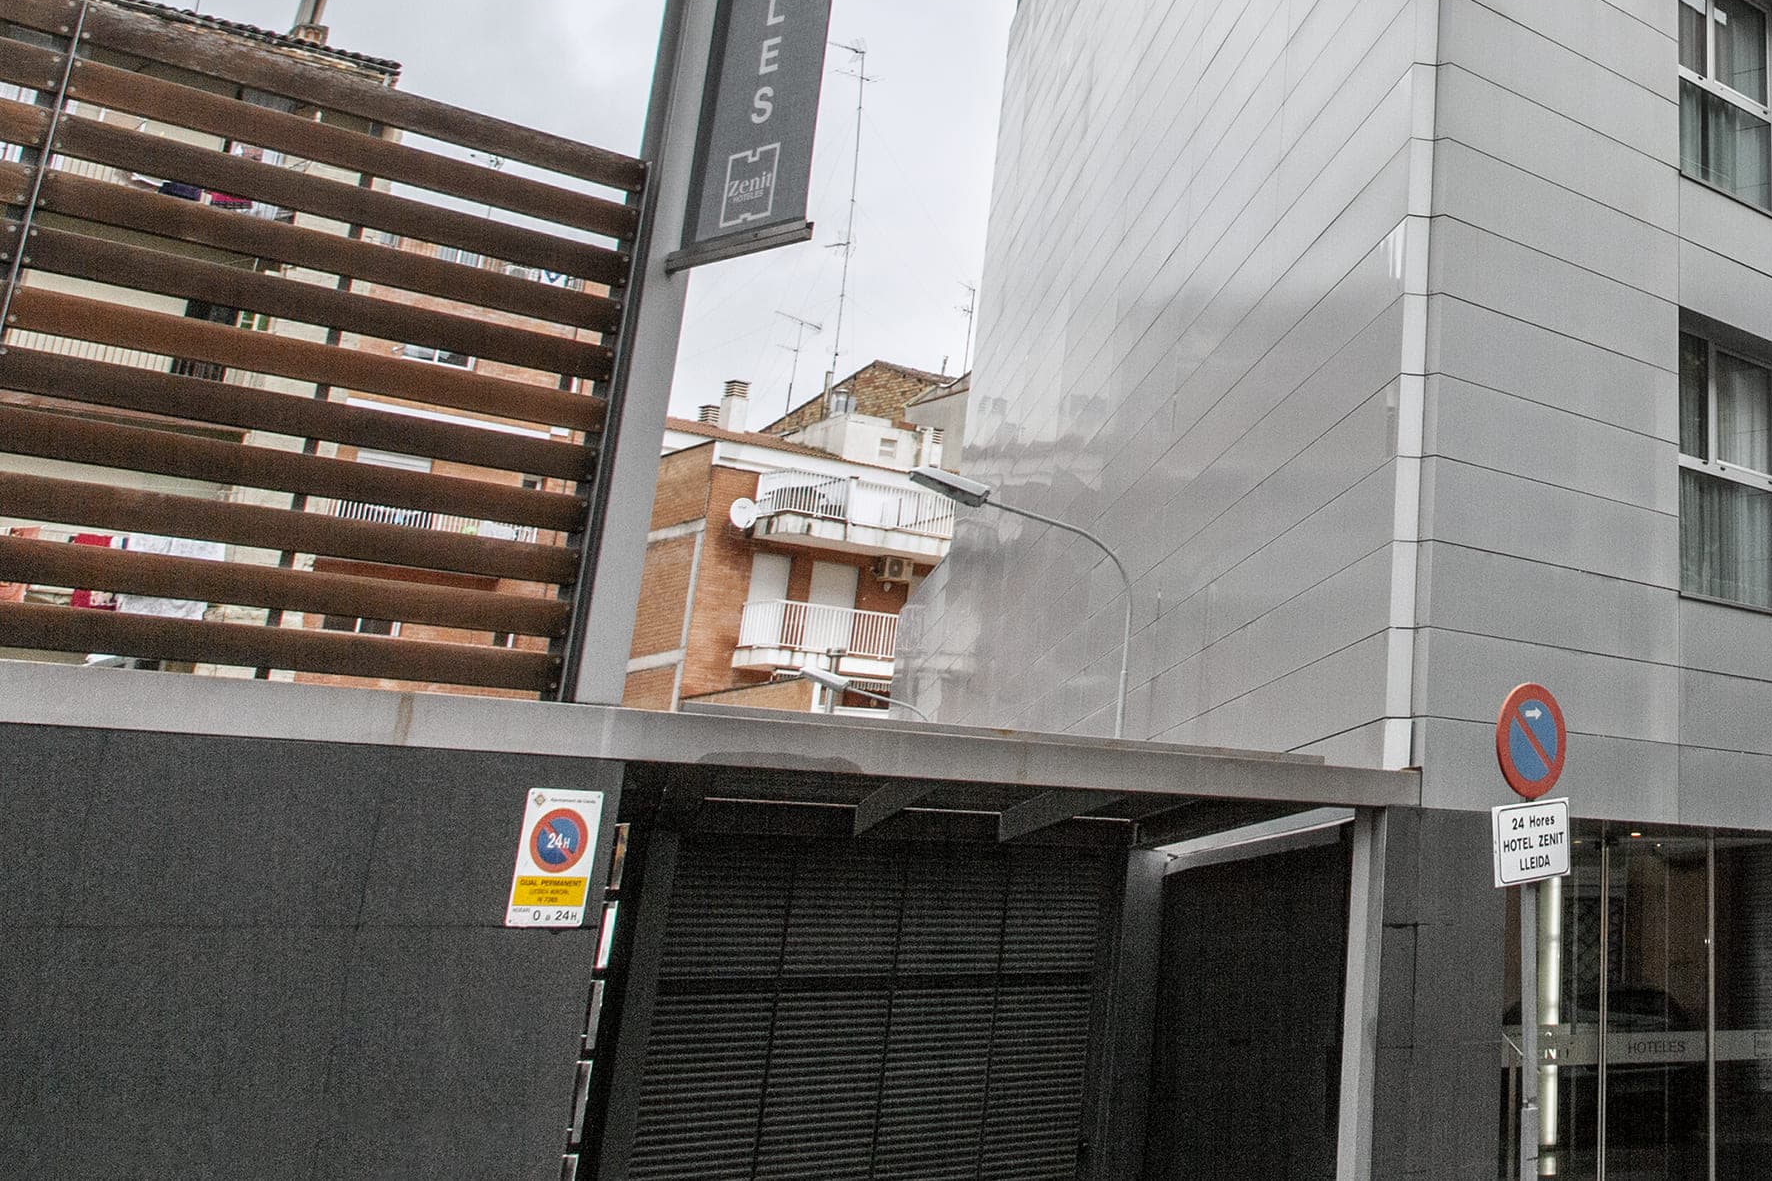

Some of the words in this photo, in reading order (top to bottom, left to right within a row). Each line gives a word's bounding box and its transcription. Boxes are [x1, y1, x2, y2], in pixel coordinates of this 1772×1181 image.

[1512, 816, 1524, 830] 24
[1529, 815, 1555, 828] Hores
[547, 832, 570, 849] 24H
[1503, 836, 1534, 852] HOTEL
[1538, 831, 1564, 847] ZENIT
[1520, 854, 1551, 871] LLEIDA
[533, 910, 541, 921] 0
[1627, 1040, 1685, 1055] HOTELES
